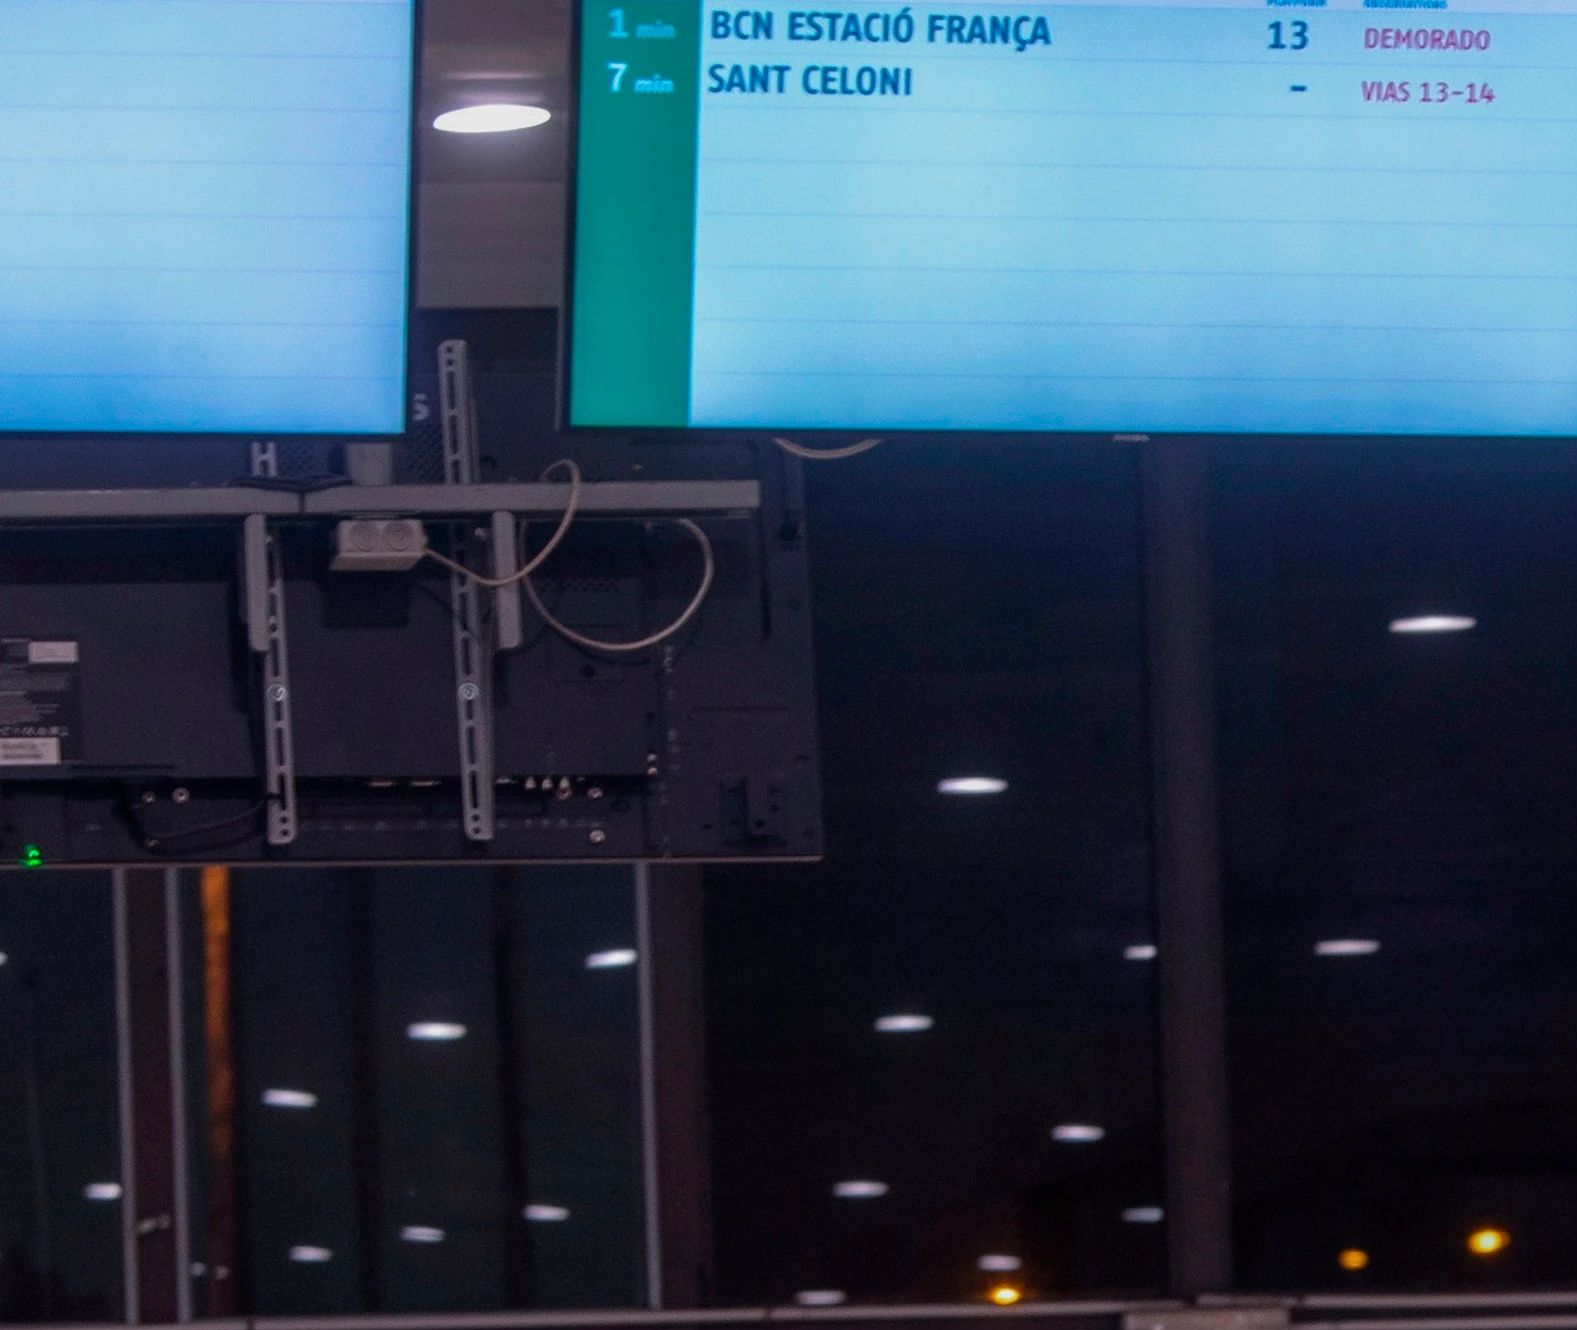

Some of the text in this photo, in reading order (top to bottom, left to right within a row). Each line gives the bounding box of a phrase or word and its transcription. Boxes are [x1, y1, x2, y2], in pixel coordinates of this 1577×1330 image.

[608, 9, 629, 39] 1
[711, 6, 1052, 52] BCN ESTACIÓ FRANÇA
[1267, 20, 1309, 50] 13
[1363, 27, 1492, 50] DEMORADO
[607, 62, 629, 93] 7
[707, 63, 913, 96] SANT CELONI
[1361, 80, 1496, 103] VIAS 13-14
